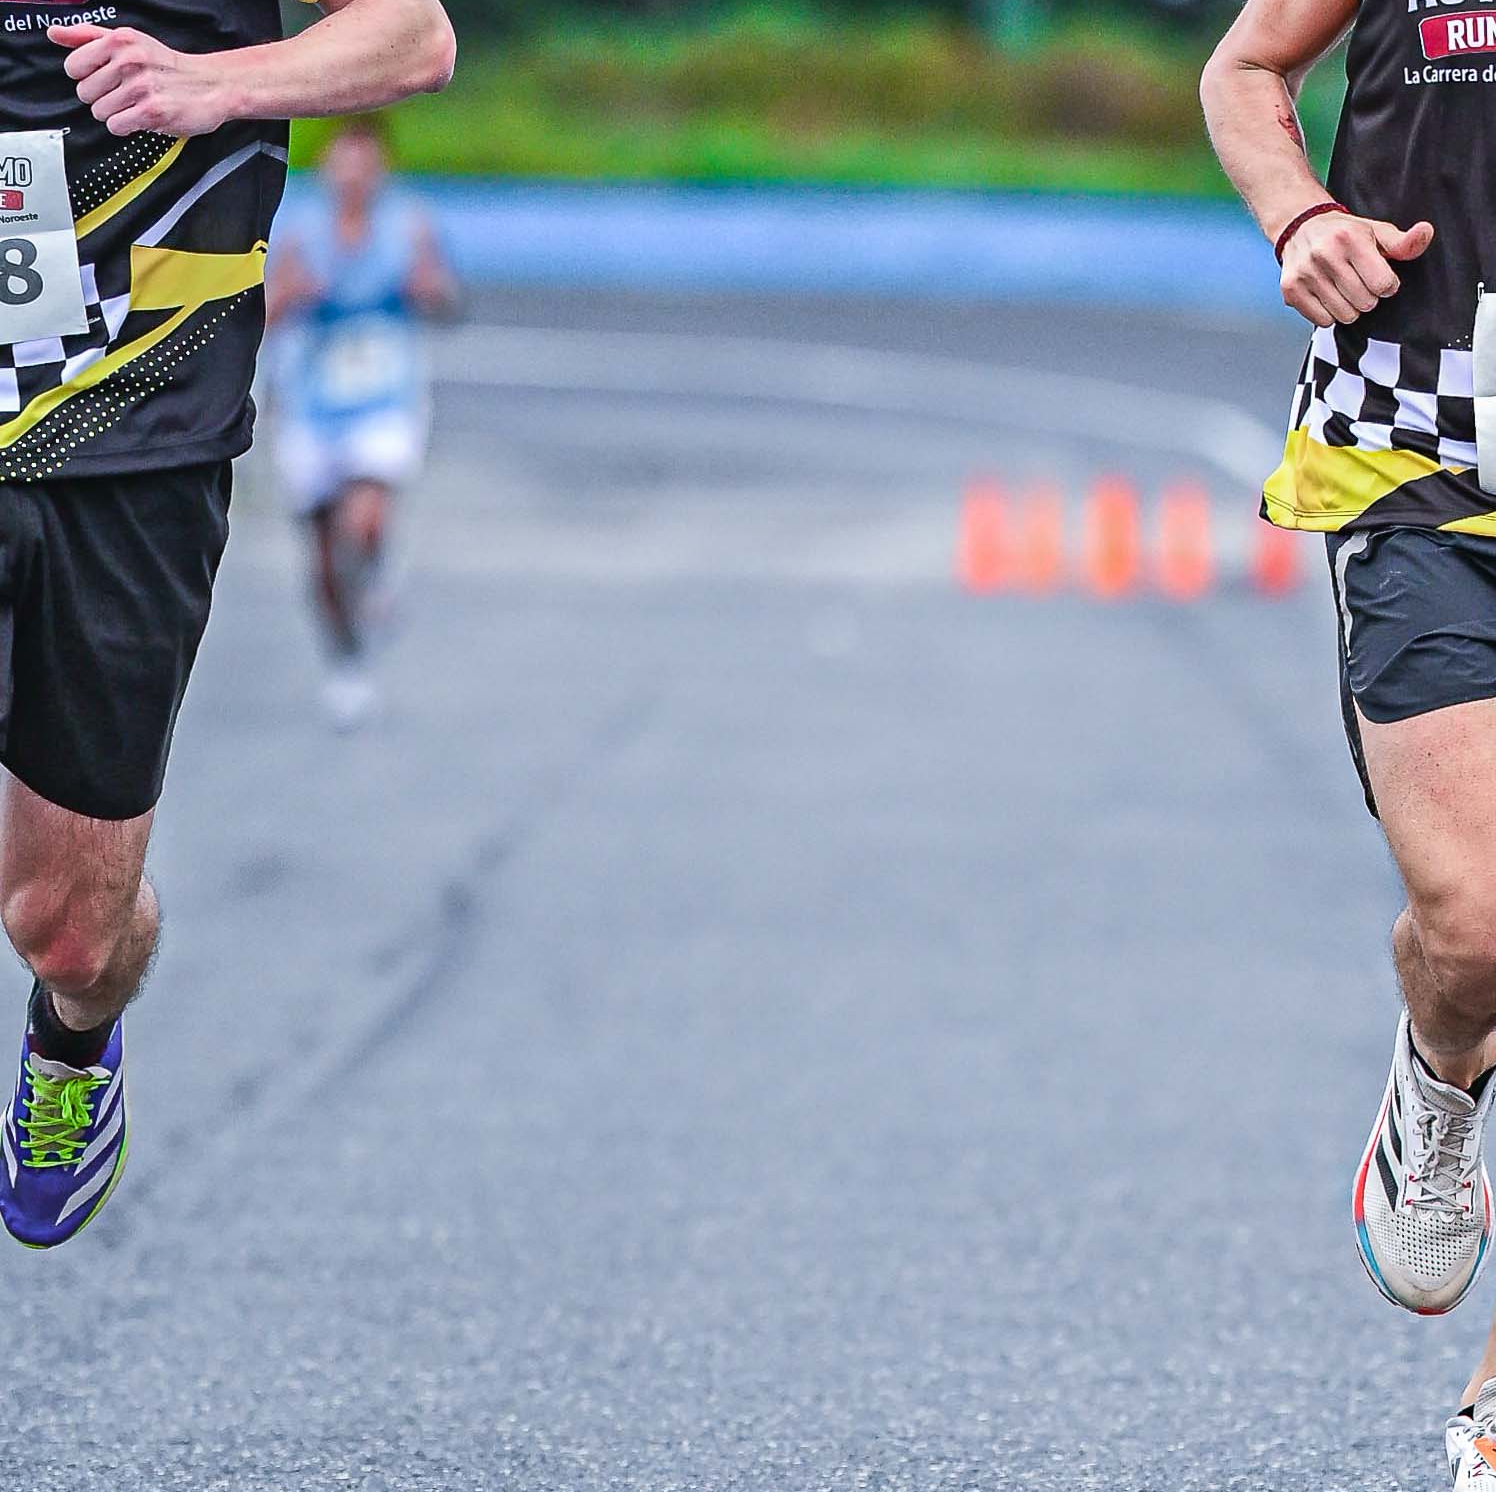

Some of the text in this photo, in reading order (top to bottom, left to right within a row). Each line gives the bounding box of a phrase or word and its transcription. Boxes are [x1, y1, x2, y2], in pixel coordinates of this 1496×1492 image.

[5, 14, 32, 32] del
[1404, 66, 1421, 85] La
[1423, 65, 1478, 84] Carrera
[0, 238, 43, 305] 8
